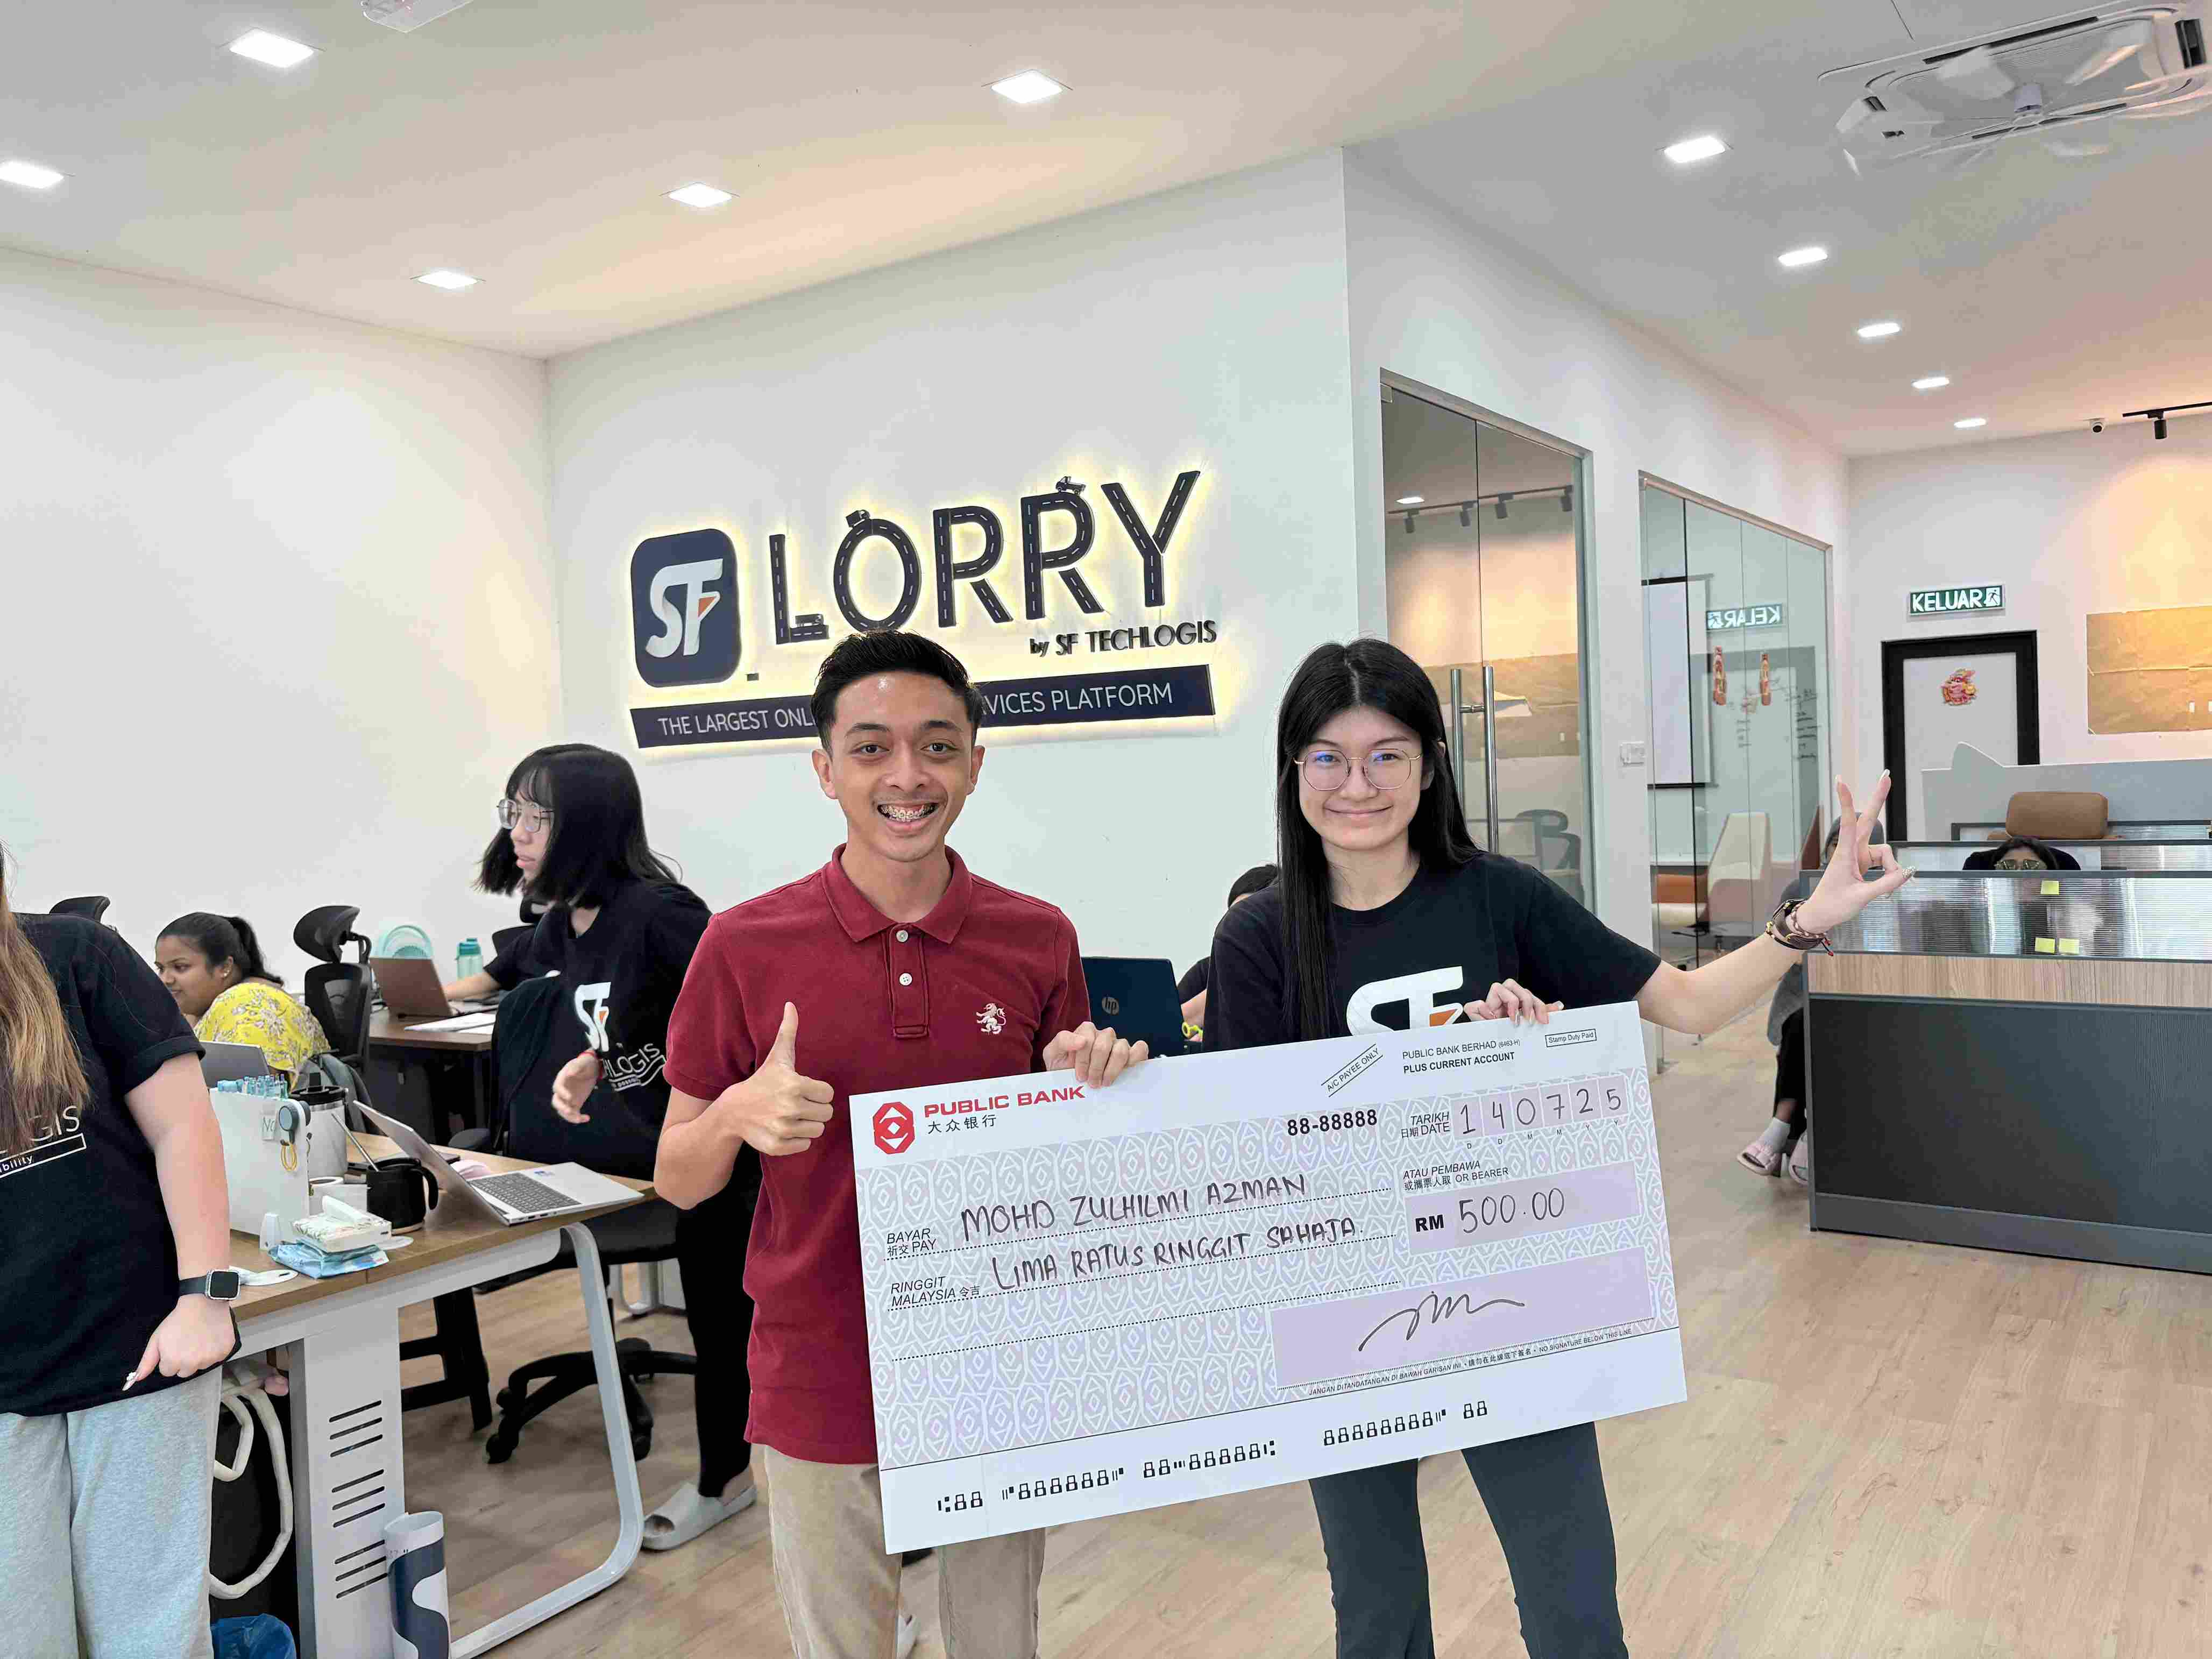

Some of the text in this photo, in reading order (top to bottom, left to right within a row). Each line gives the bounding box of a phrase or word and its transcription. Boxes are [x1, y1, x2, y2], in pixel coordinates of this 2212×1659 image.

[769, 470, 1201, 644] LORRY
[1912, 589, 1983, 612] KELUAR
[1030, 620, 1217, 657] by SF TECHLOGIS
[657, 716, 692, 736] THE
[694, 710, 769, 734] LARGEST
[982, 691, 1046, 715] VICES
[1051, 683, 1173, 711] PLATFORM
[1403, 1048, 1434, 1059] PUBLIC
[1436, 1045, 1460, 1055] BANK
[1462, 1040, 1497, 1052] BERHAD
[1327, 1048, 1379, 1092] A/C PAYEE ONLY
[1403, 1052, 1515, 1073] PLUS CURRENT ACCOUNT
[925, 1086, 1085, 1118] PUBLIC BANK
[927, 1114, 997, 1135] 大众银行
[1287, 1109, 1378, 1136] 88-88888
[1410, 1111, 1449, 1125] TARIKH
[1401, 1127, 1419, 1138] 日期
[1421, 1122, 1450, 1136] DATE
[1403, 1160, 1480, 1180] ATAU PEMBAWA
[1455, 1167, 1509, 1183] OR BEARER
[961, 1174, 1306, 1242] MOHD ZULHILMI AZMAN
[1458, 1187, 1565, 1233] 500.00
[1415, 1214, 1445, 1232] RM
[887, 1228, 931, 1244] BAYAR
[912, 1238, 937, 1253] PAY
[992, 1254, 1058, 1290] LIMA
[1071, 1243, 1144, 1278] RATUS
[1153, 1232, 1251, 1265] RINGGIT
[891, 1276, 946, 1294] RINGGIT
[959, 1285, 981, 1297] 令吉
[892, 1288, 956, 1307] MALAYSIA
[1539, 1344, 1548, 1352] NO
[1549, 1338, 1582, 1351] SIGNATURE
[1583, 1334, 1604, 1343] BELOW
[1308, 1384, 1335, 1395] JANGAN
[1399, 1370, 1422, 1379] BAWAH
[1423, 1364, 1451, 1376] GARISAN
